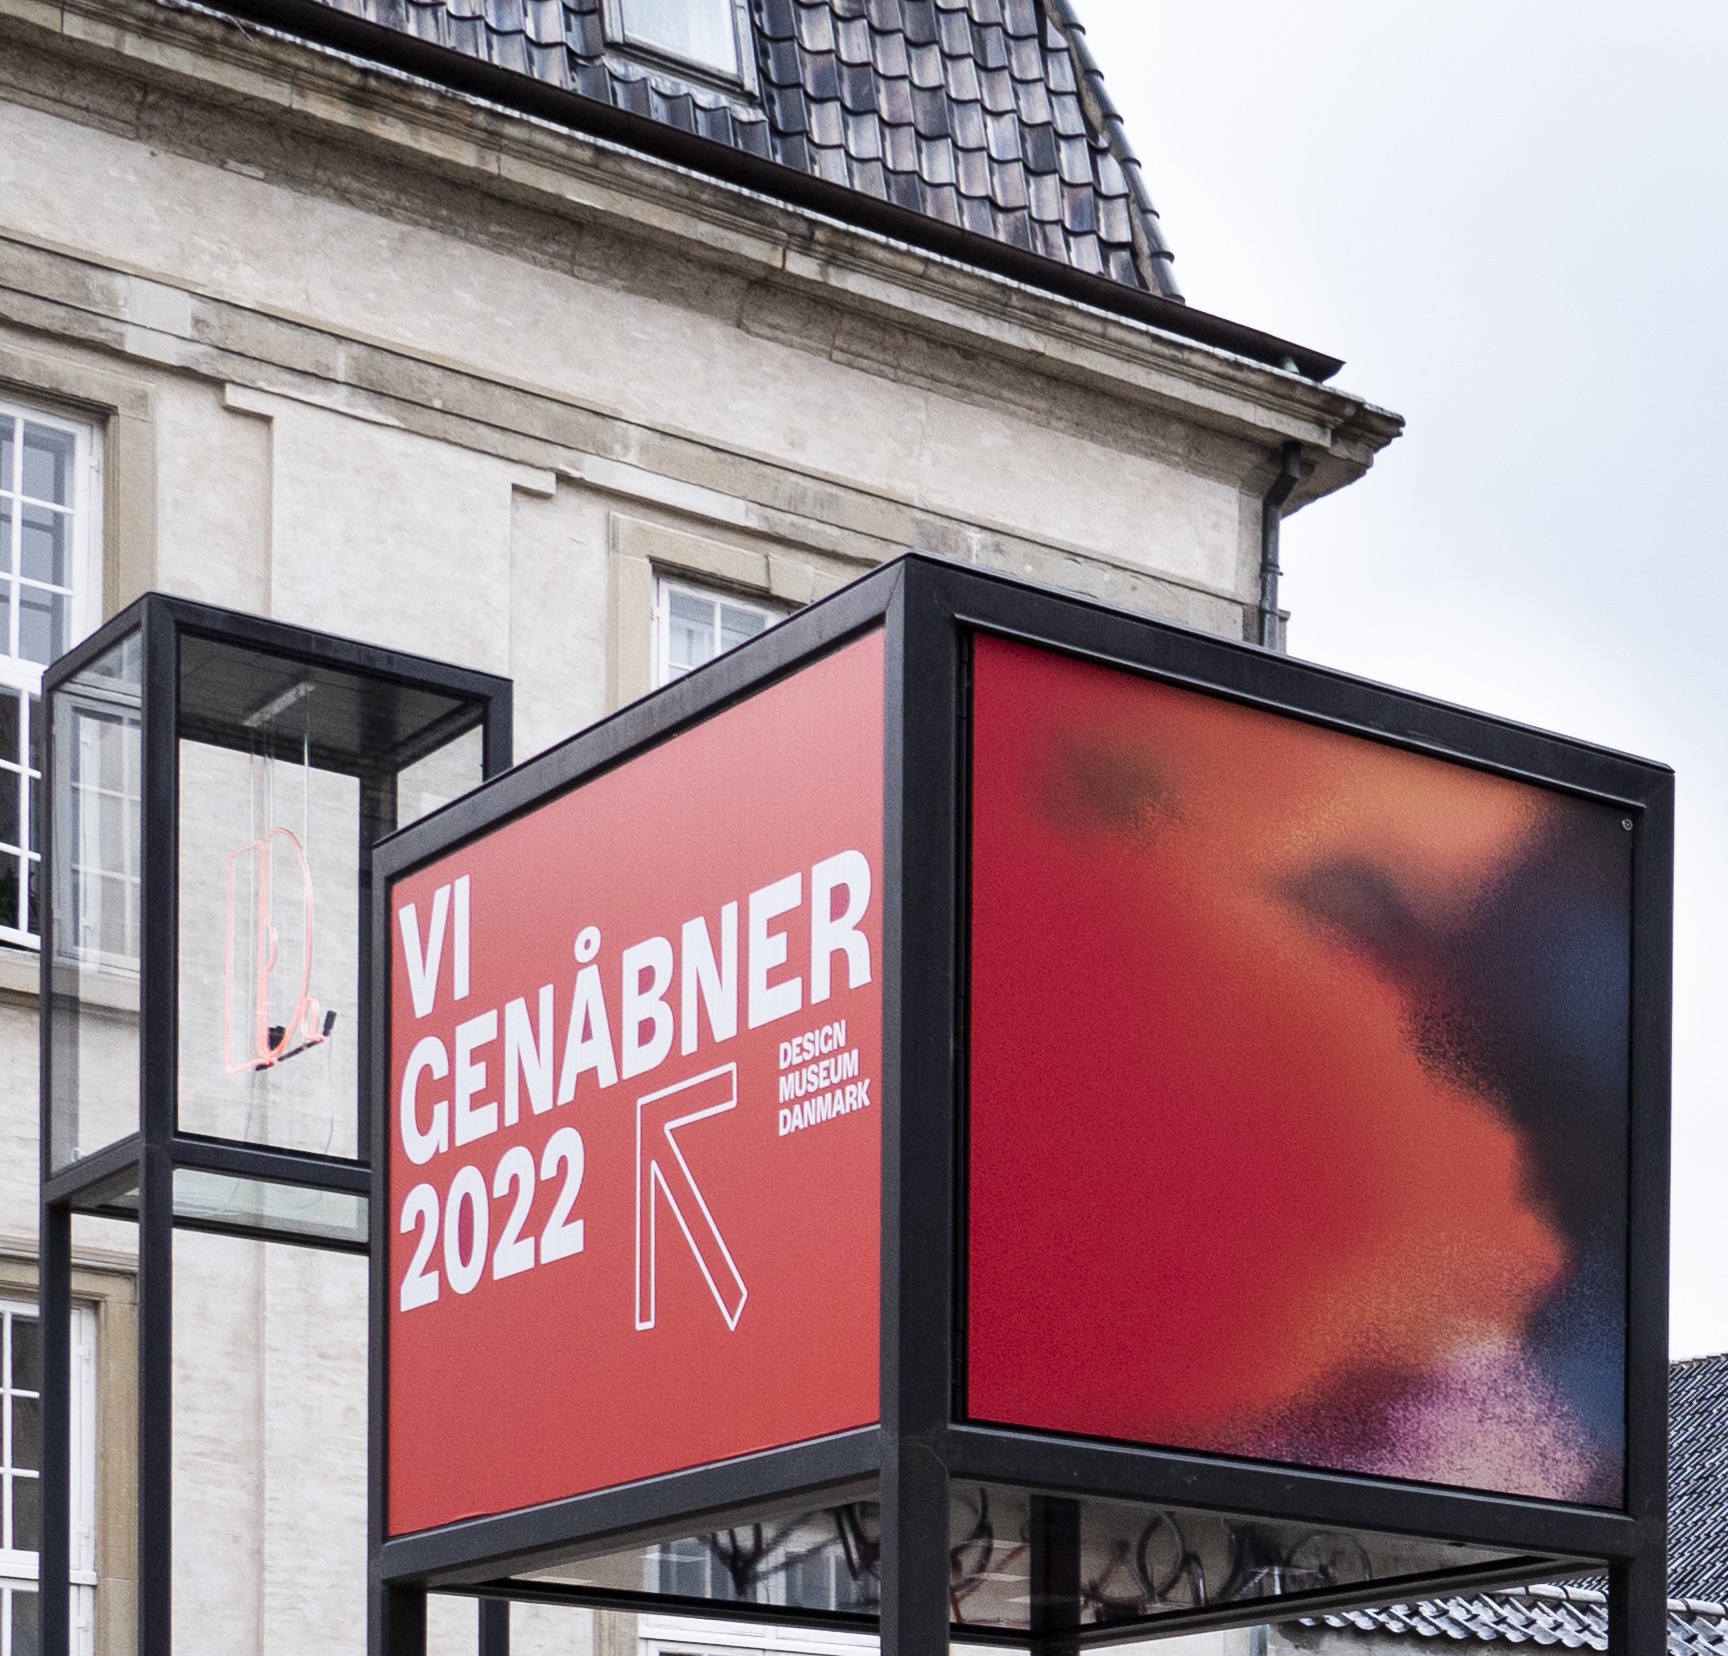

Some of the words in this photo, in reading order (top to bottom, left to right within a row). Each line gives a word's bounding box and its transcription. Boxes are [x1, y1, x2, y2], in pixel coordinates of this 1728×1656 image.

[398, 873, 471, 1019] VI
[399, 849, 873, 1165] GENÅBNER
[778, 1019, 847, 1070] DESIGN
[778, 1048, 859, 1104] MUSEUM
[778, 1078, 871, 1137] DANMARK
[400, 1126, 585, 1313] 2022
